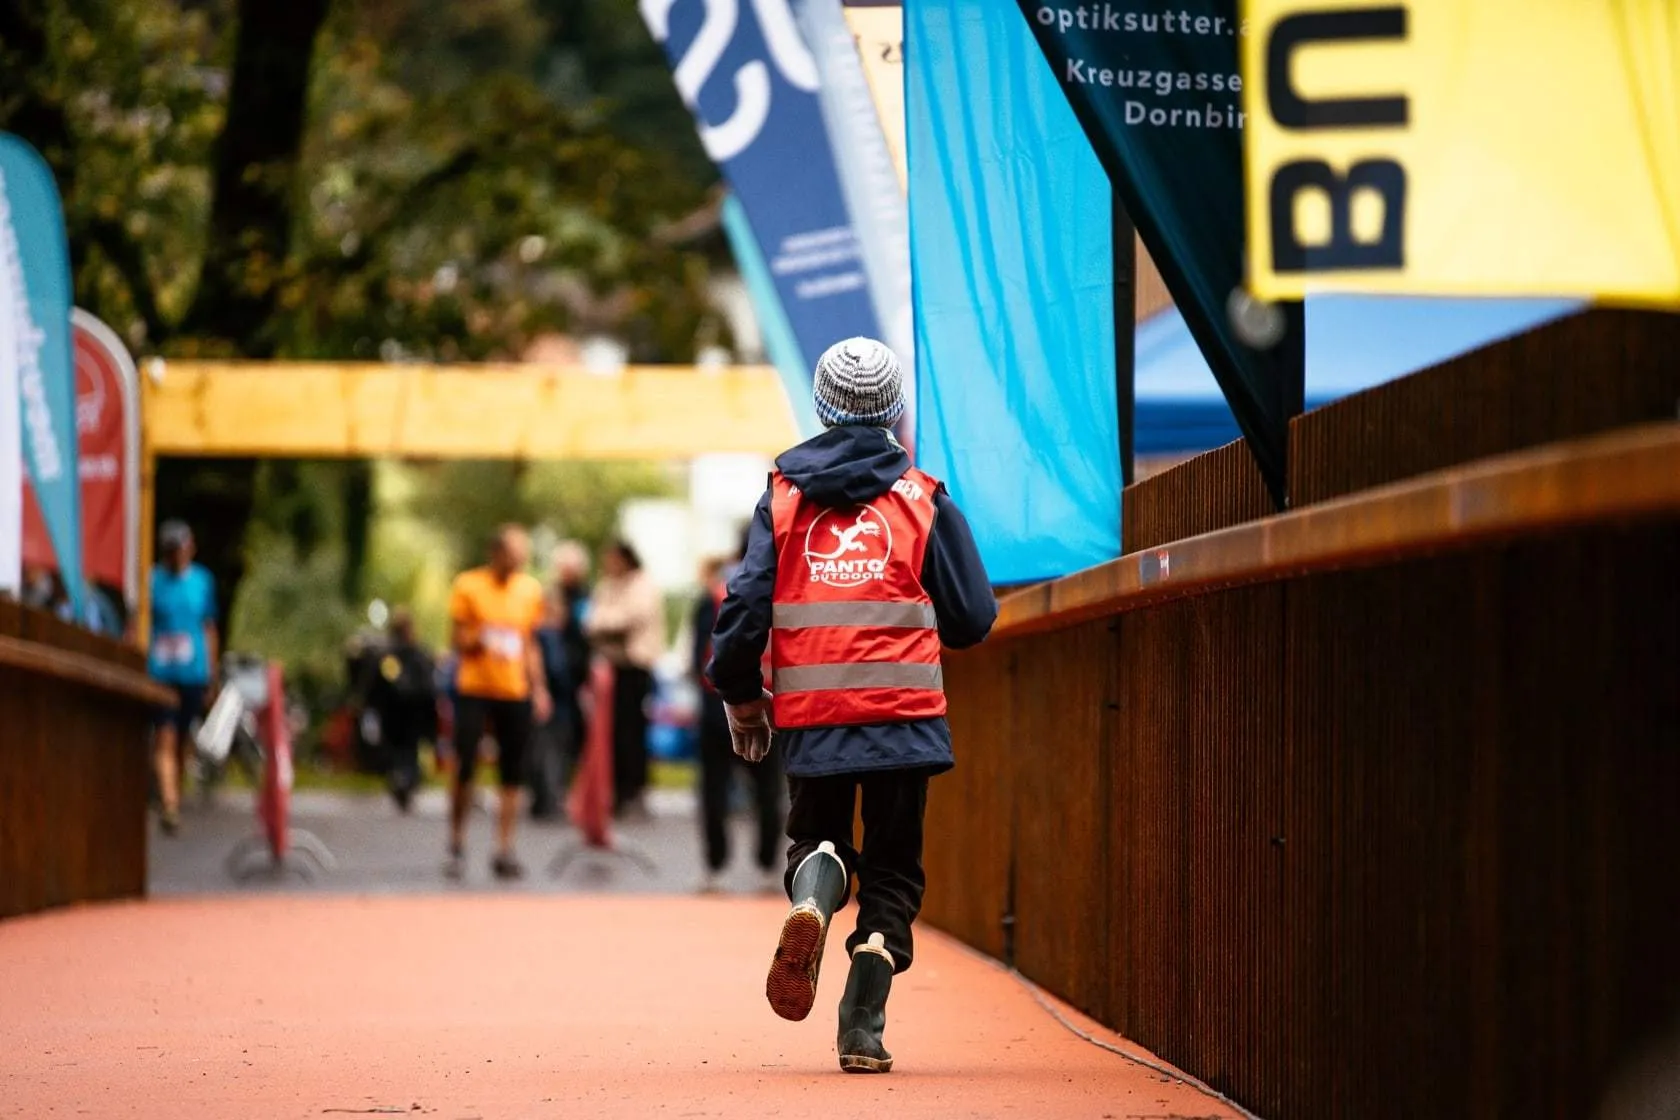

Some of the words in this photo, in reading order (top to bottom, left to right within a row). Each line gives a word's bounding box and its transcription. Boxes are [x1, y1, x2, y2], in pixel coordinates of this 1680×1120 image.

[1037, 3, 1251, 37] optiksutter.a
[1066, 58, 1242, 96] Kreuzgasse
[1125, 101, 1249, 129] Dornbir
[810, 572, 885, 582] OUTDOOR
[811, 559, 885, 575] PANTO
